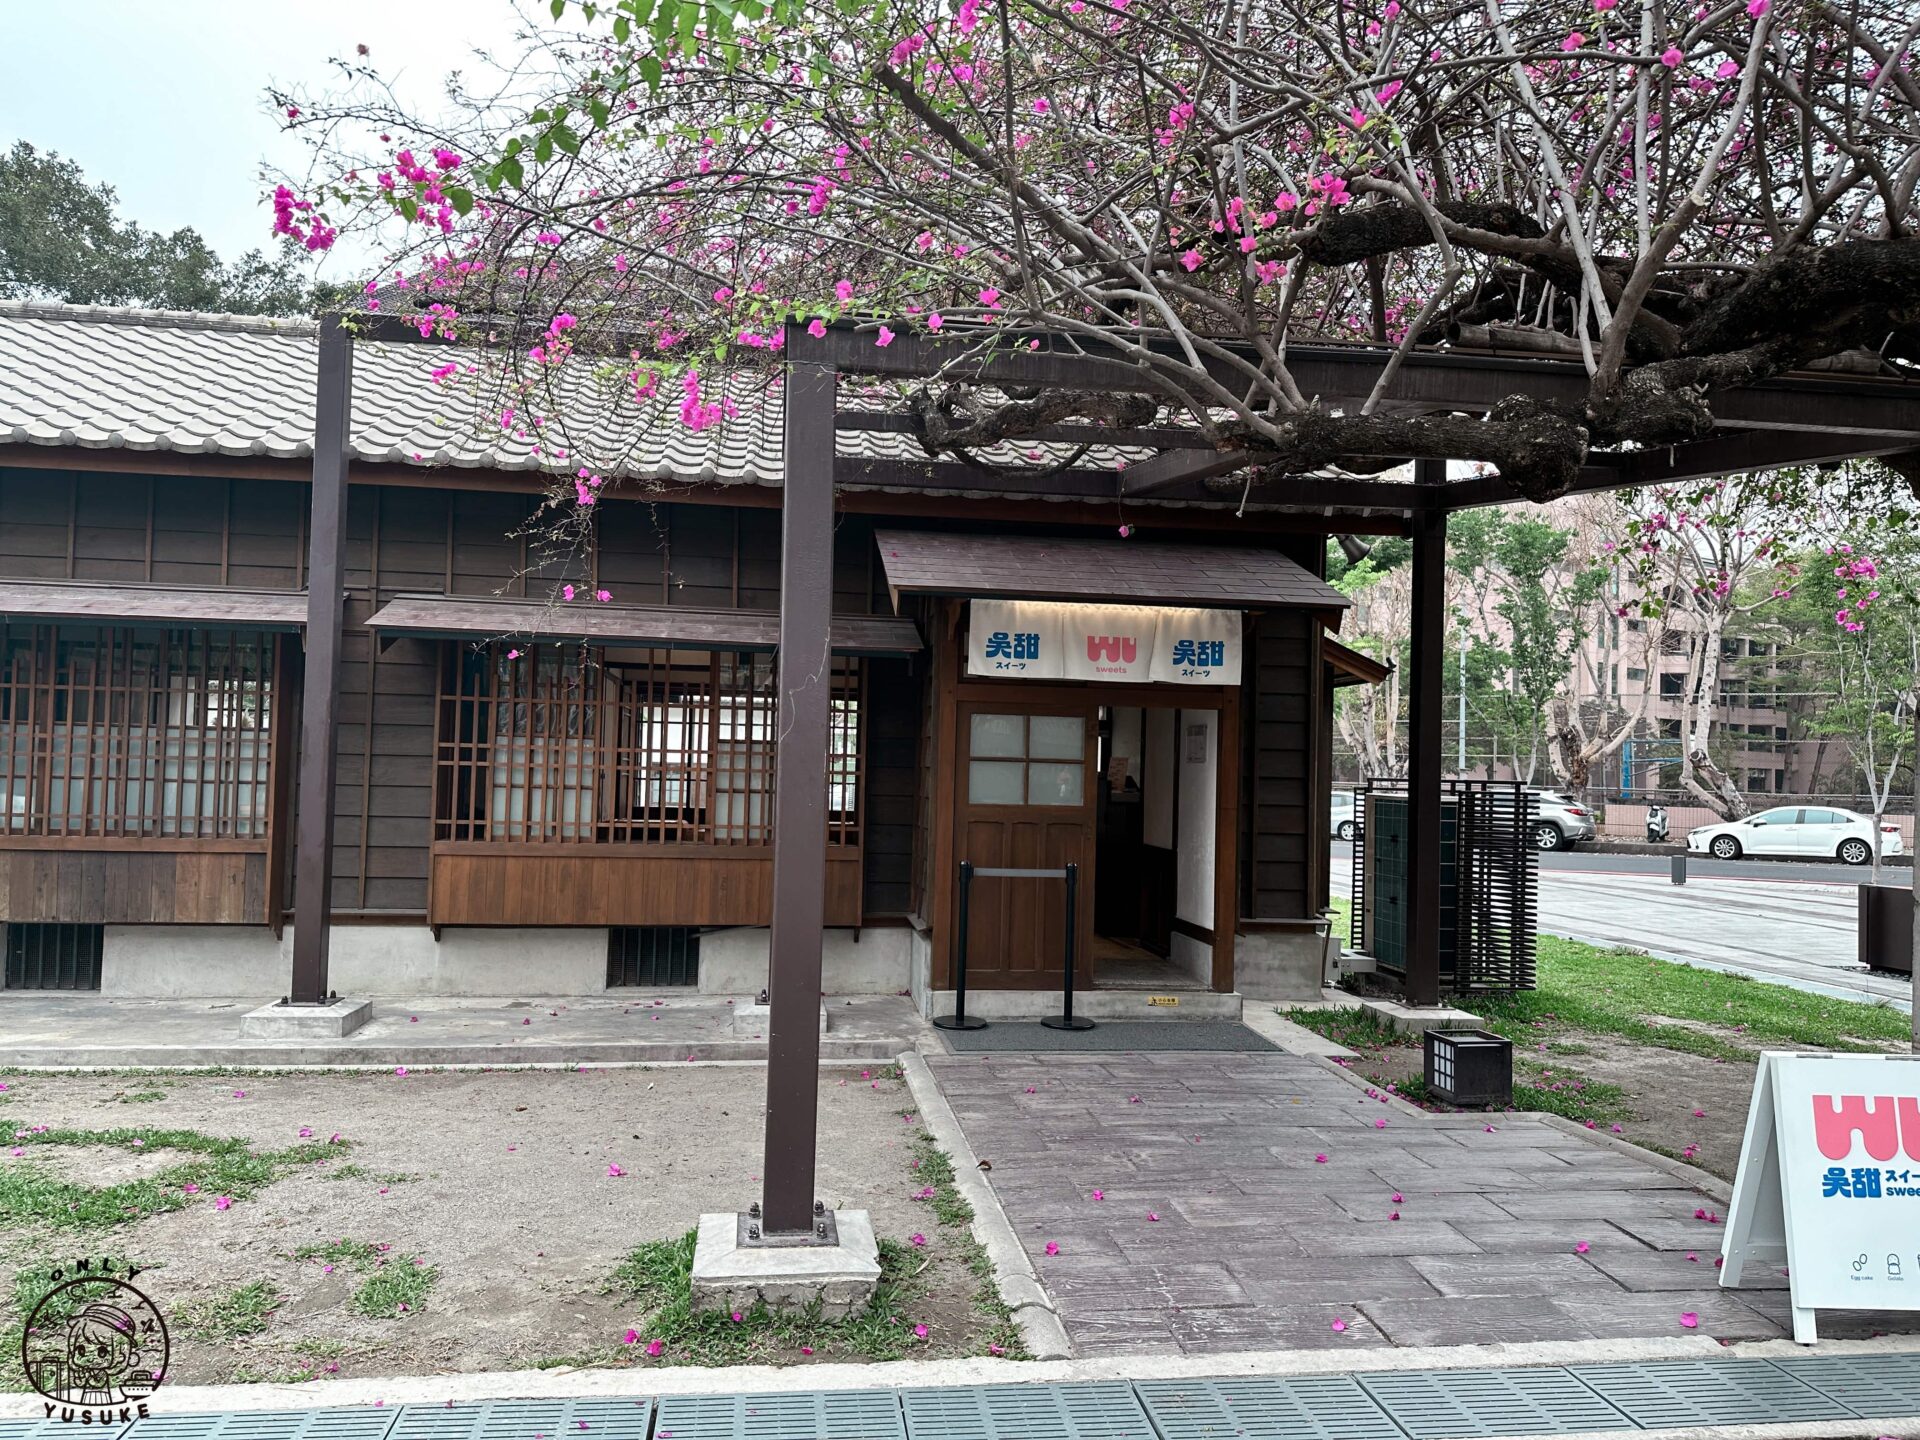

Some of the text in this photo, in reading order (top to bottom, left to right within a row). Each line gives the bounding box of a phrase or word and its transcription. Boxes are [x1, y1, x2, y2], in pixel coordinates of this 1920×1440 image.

[986, 632, 1040, 659] 吳甜
[1172, 640, 1225, 666] 吳甜
[996, 662, 1026, 670] スイーツ
[1096, 666, 1127, 674] sweets
[1181, 669, 1211, 678] スイーツ
[1822, 1167, 1882, 1198] 吳甜
